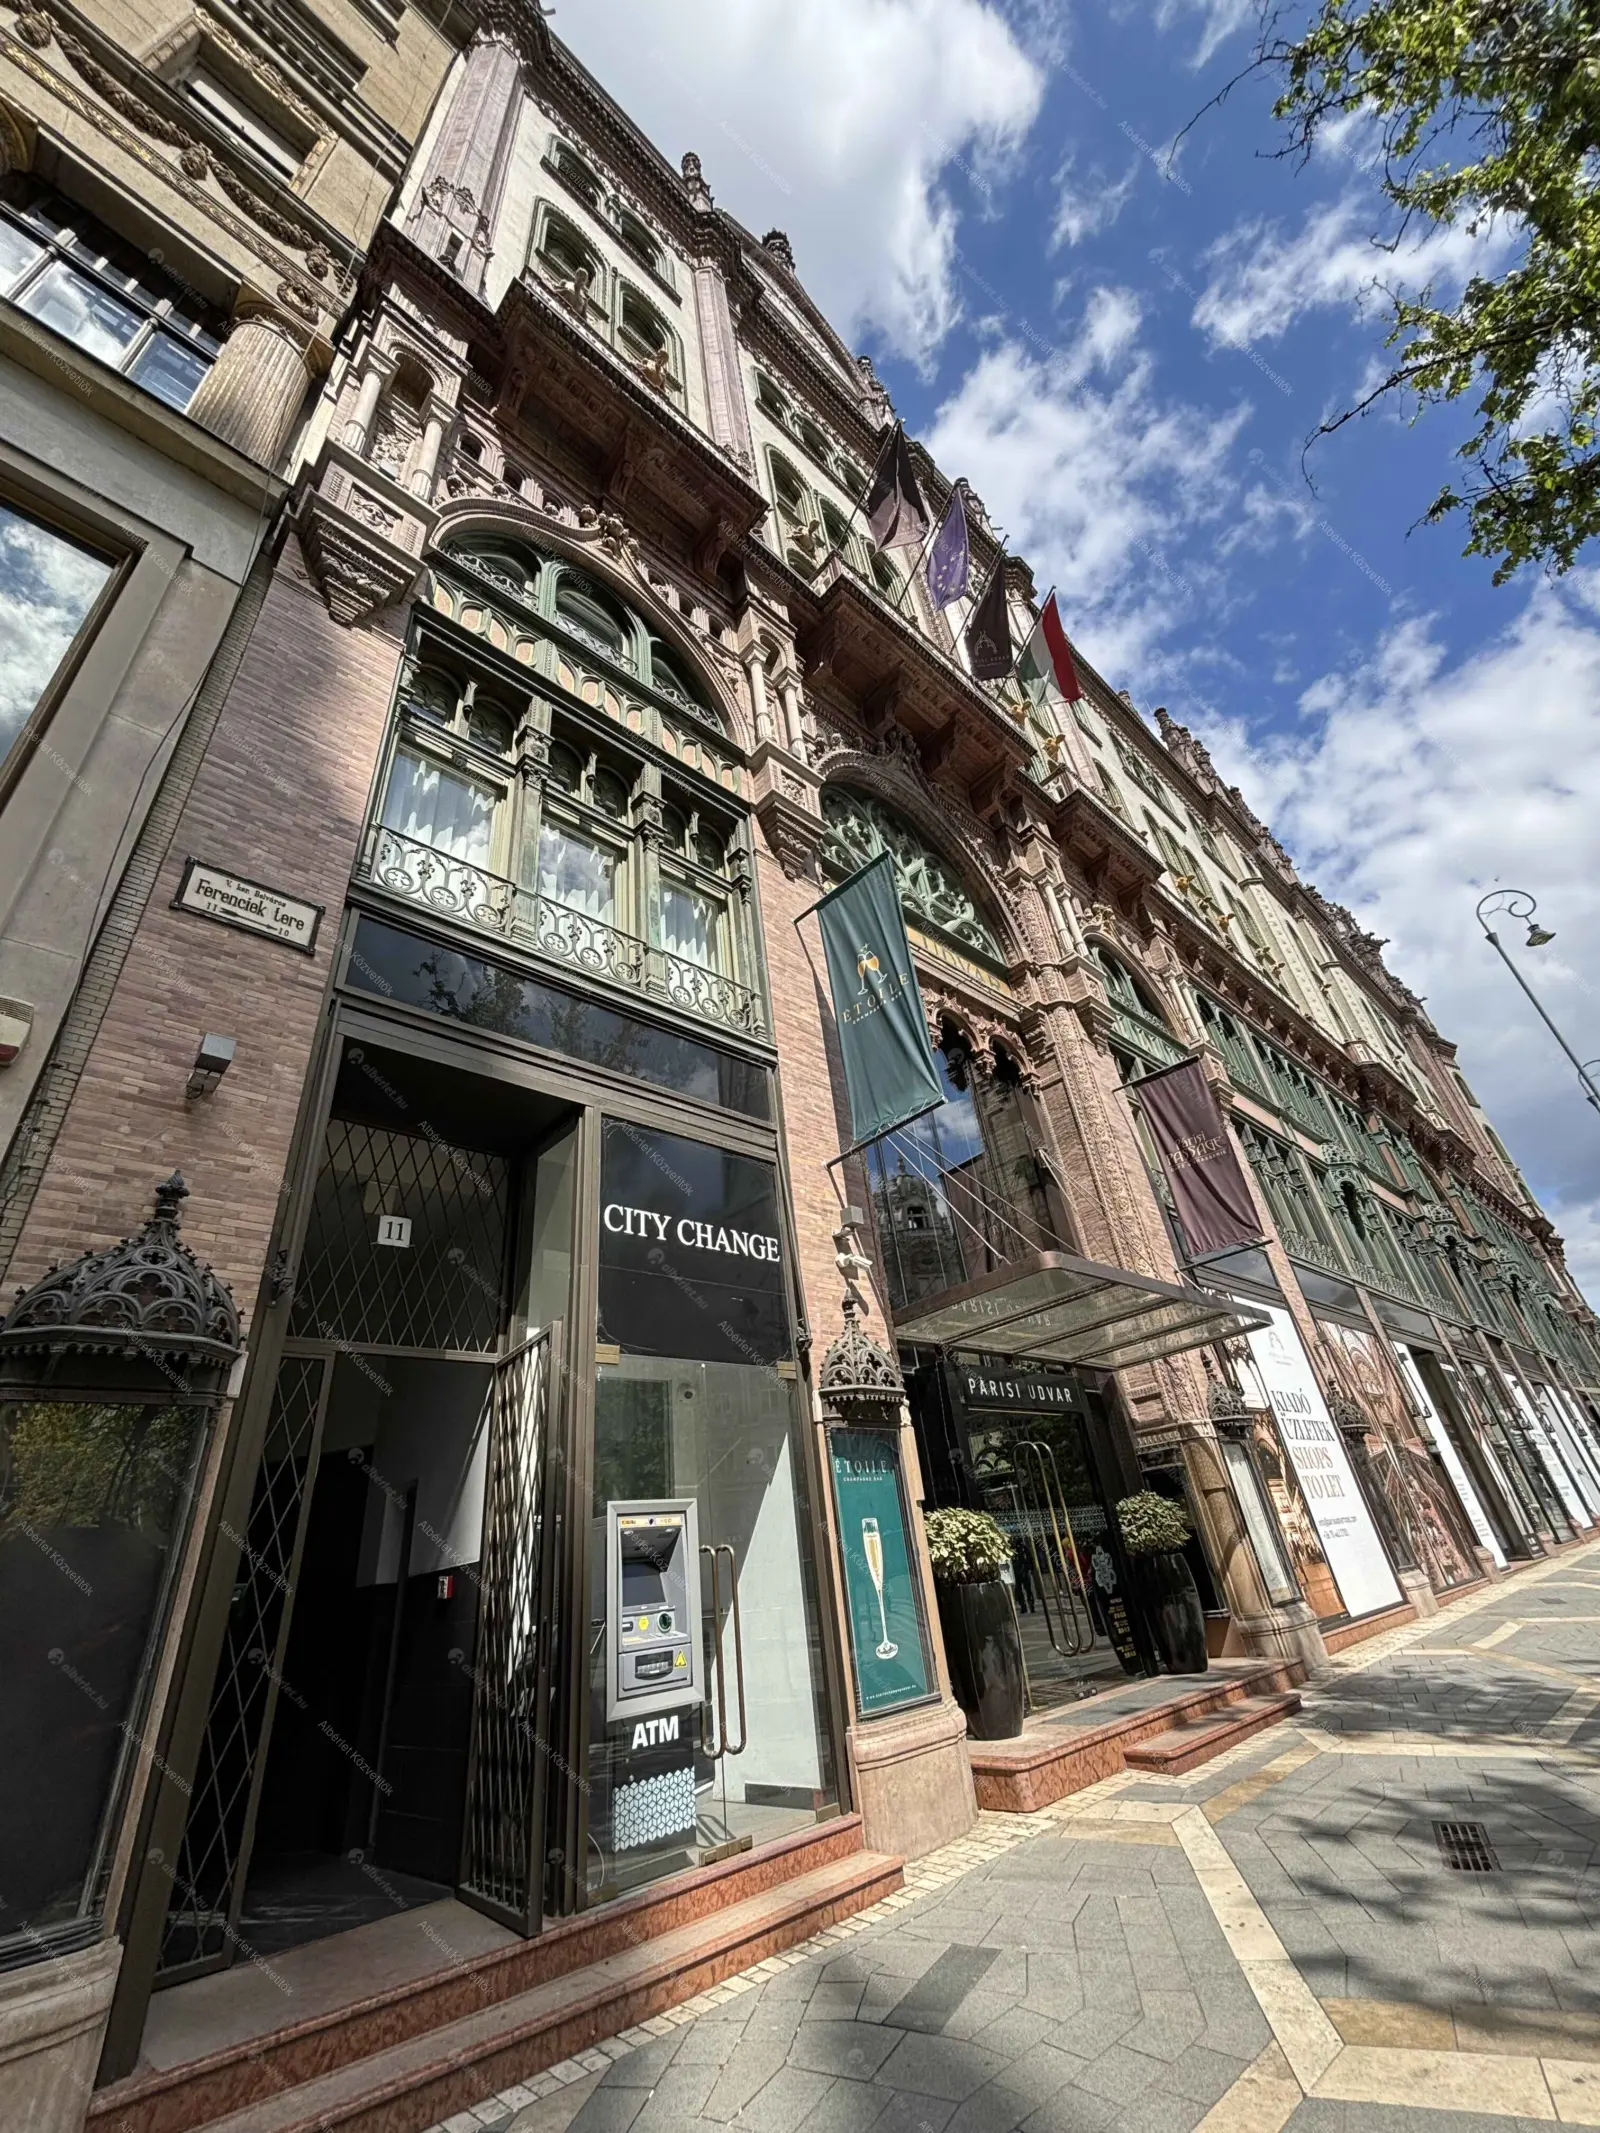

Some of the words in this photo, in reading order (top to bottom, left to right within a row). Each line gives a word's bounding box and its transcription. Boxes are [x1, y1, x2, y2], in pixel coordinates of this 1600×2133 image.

[194, 878, 267, 918] Ferenciek
[274, 908, 305, 931] tere
[225, 879, 232, 888] V.
[236, 884, 250, 894] ker.
[254, 890, 287, 908] Belváros
[206, 902, 218, 912] 11
[278, 928, 290, 937] 10
[1166, 1136, 1223, 1166] PASSAGE
[385, 1221, 404, 1241] 11
[604, 1204, 672, 1241] CITY
[676, 1219, 780, 1262] CHANGE
[1028, 1384, 1073, 1403] UDVAR
[1270, 1388, 1312, 1415] KIADÓ
[1280, 1412, 1336, 1442] ÜZLETEK
[1292, 1446, 1334, 1470] SHOPS
[1302, 1475, 1324, 1499] TO
[1322, 1474, 1346, 1498] LET
[632, 1715, 679, 1750] ATM
